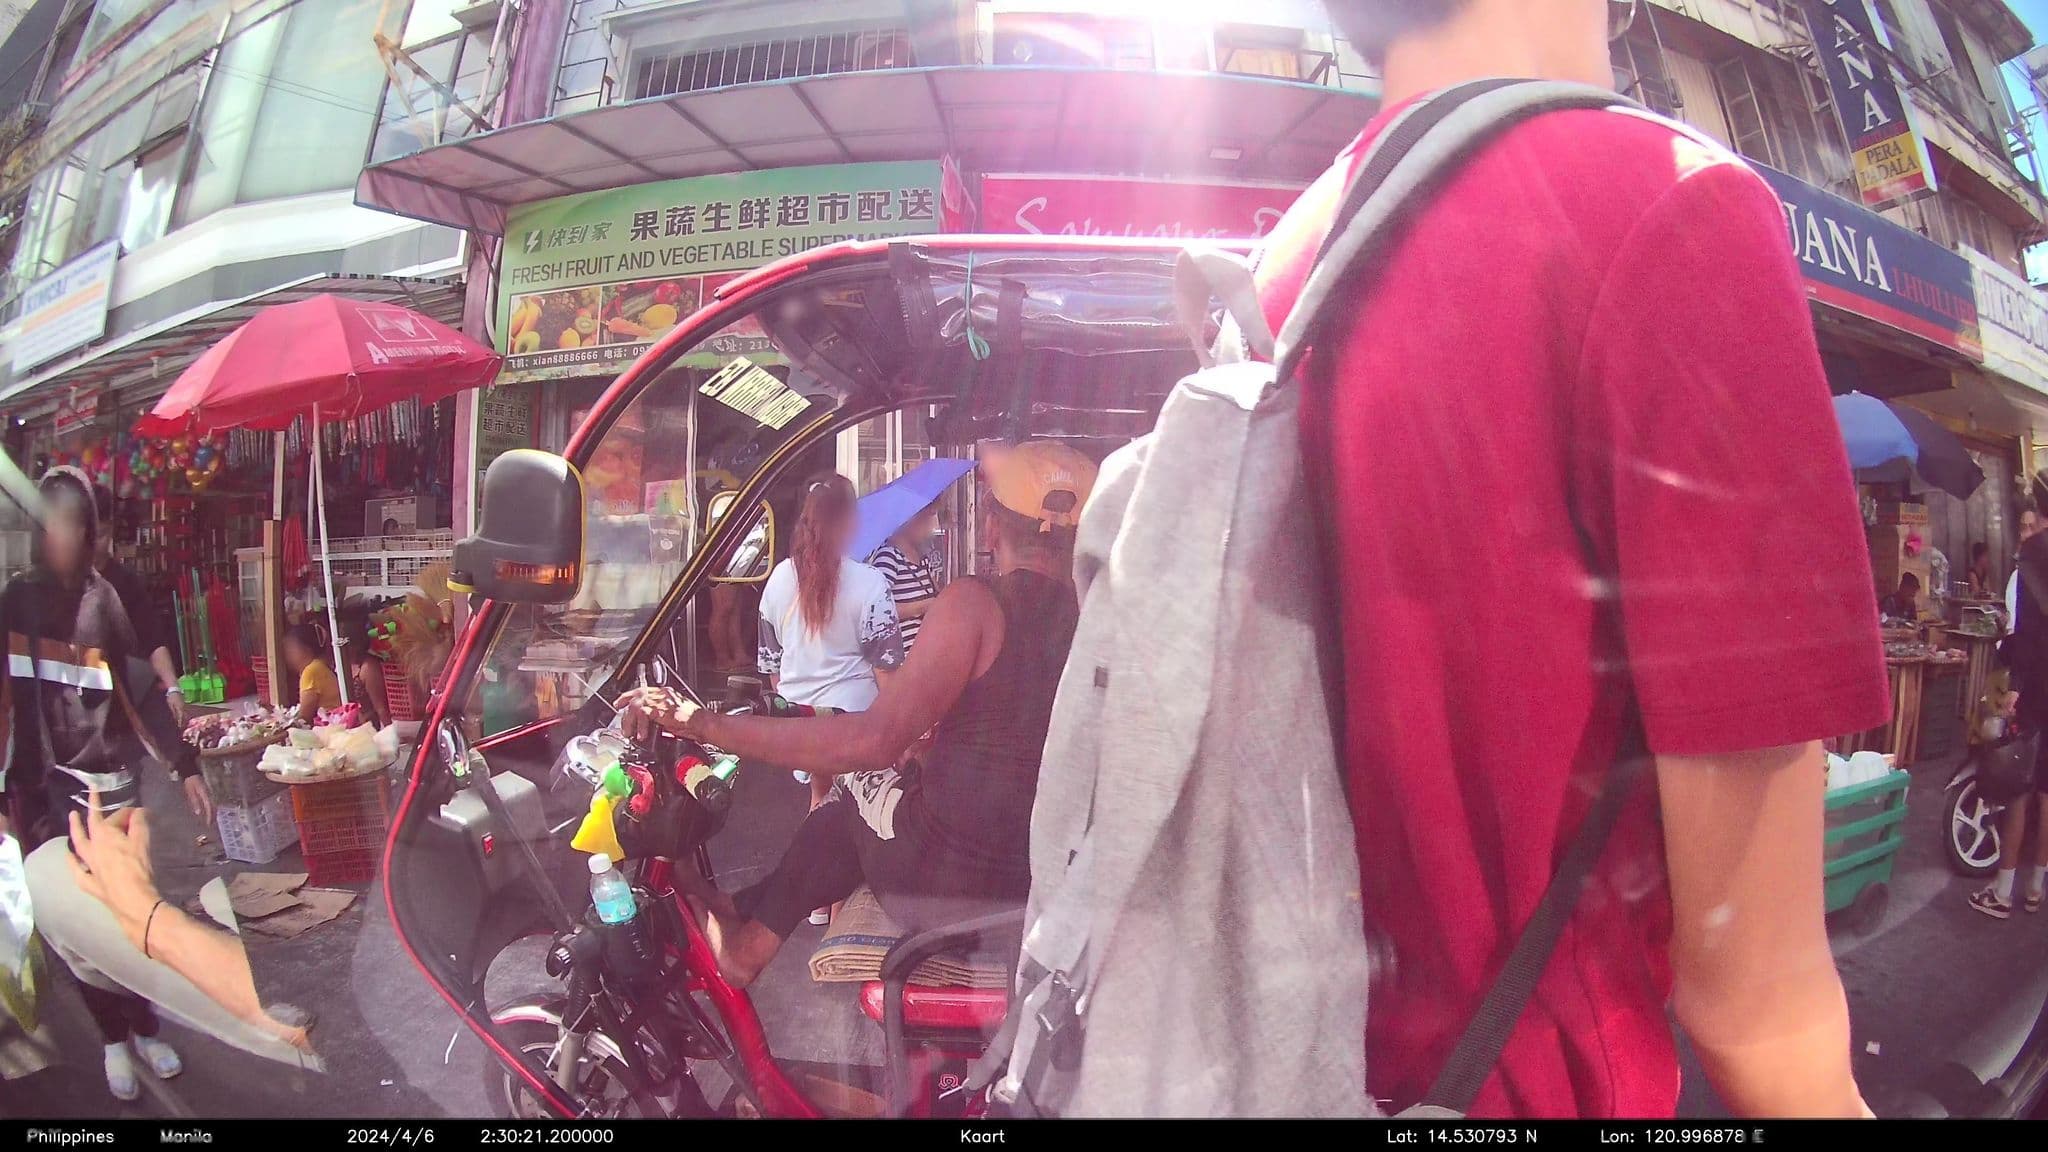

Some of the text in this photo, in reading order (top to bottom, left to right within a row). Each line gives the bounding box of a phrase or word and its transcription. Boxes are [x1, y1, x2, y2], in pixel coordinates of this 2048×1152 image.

[1824, 0, 1892, 132] ANA
[1866, 141, 1903, 165] PERA
[548, 222, 612, 248] 快到家
[630, 189, 934, 242] 果蔬生鲜超市配送
[511, 262, 563, 286] FRESH
[565, 255, 615, 278] FRUIT
[617, 250, 654, 271] AND
[659, 239, 774, 267] VEGETABLE
